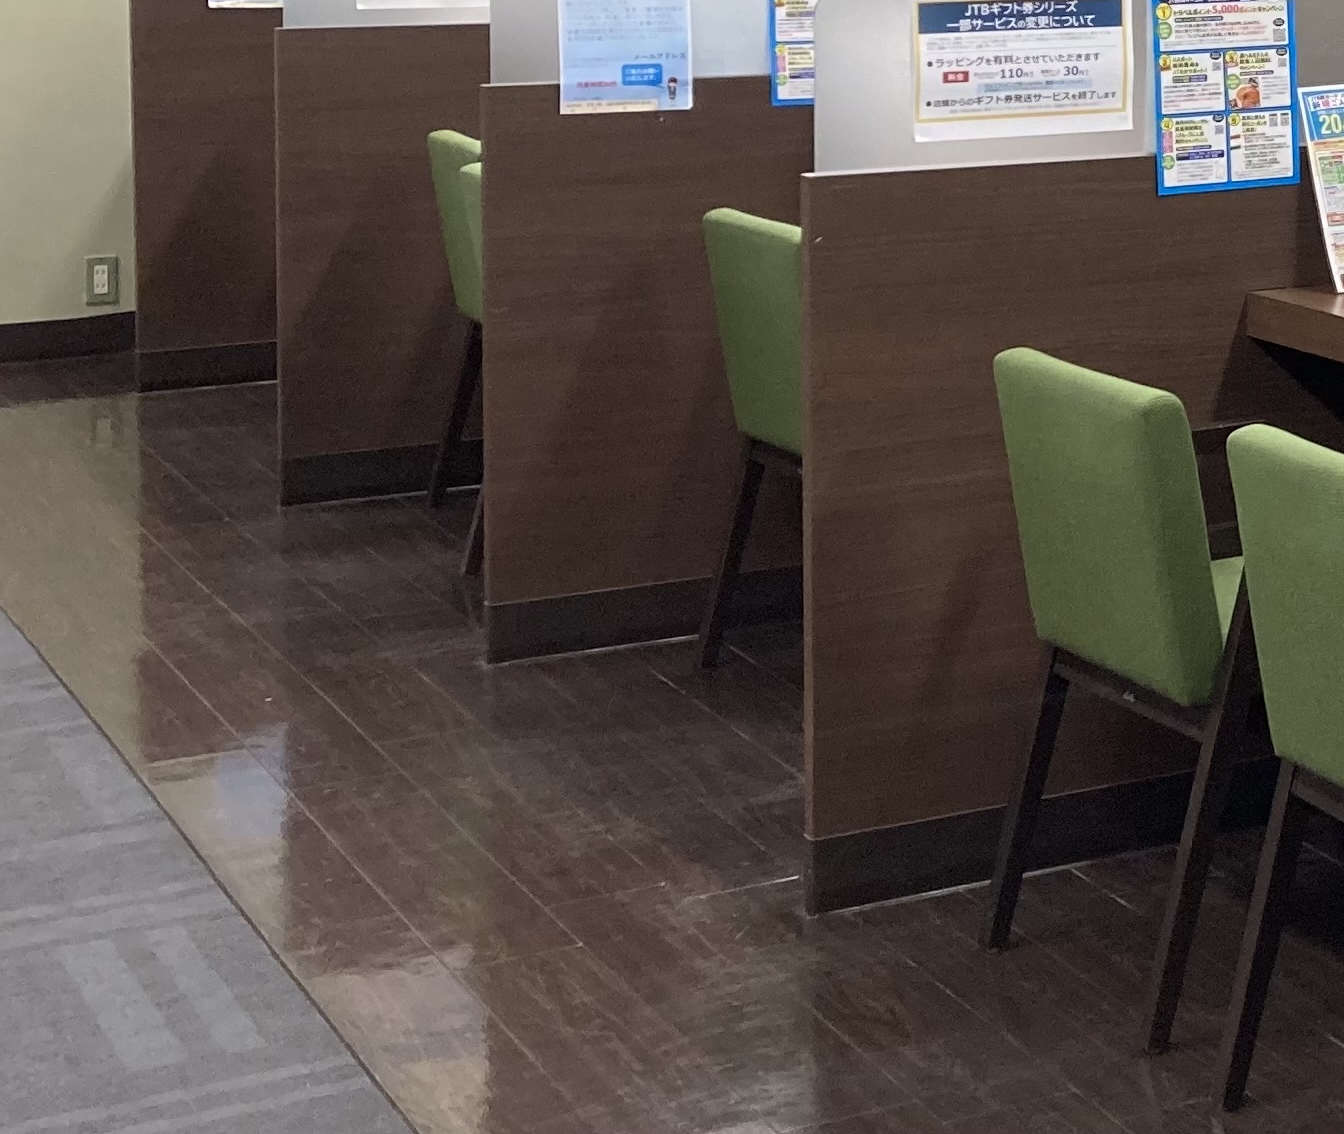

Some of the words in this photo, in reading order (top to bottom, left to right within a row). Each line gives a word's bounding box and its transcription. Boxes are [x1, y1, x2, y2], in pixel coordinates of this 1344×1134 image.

[964, 0, 1078, 17] JTBギフト券シリーズ
[946, 15, 1096, 32] 一部サービスの変更について
[935, 52, 1101, 68] ラッピングを有料とさせていただきます
[934, 91, 1117, 108] 店舗からのギフト券発送サービスを終了します
